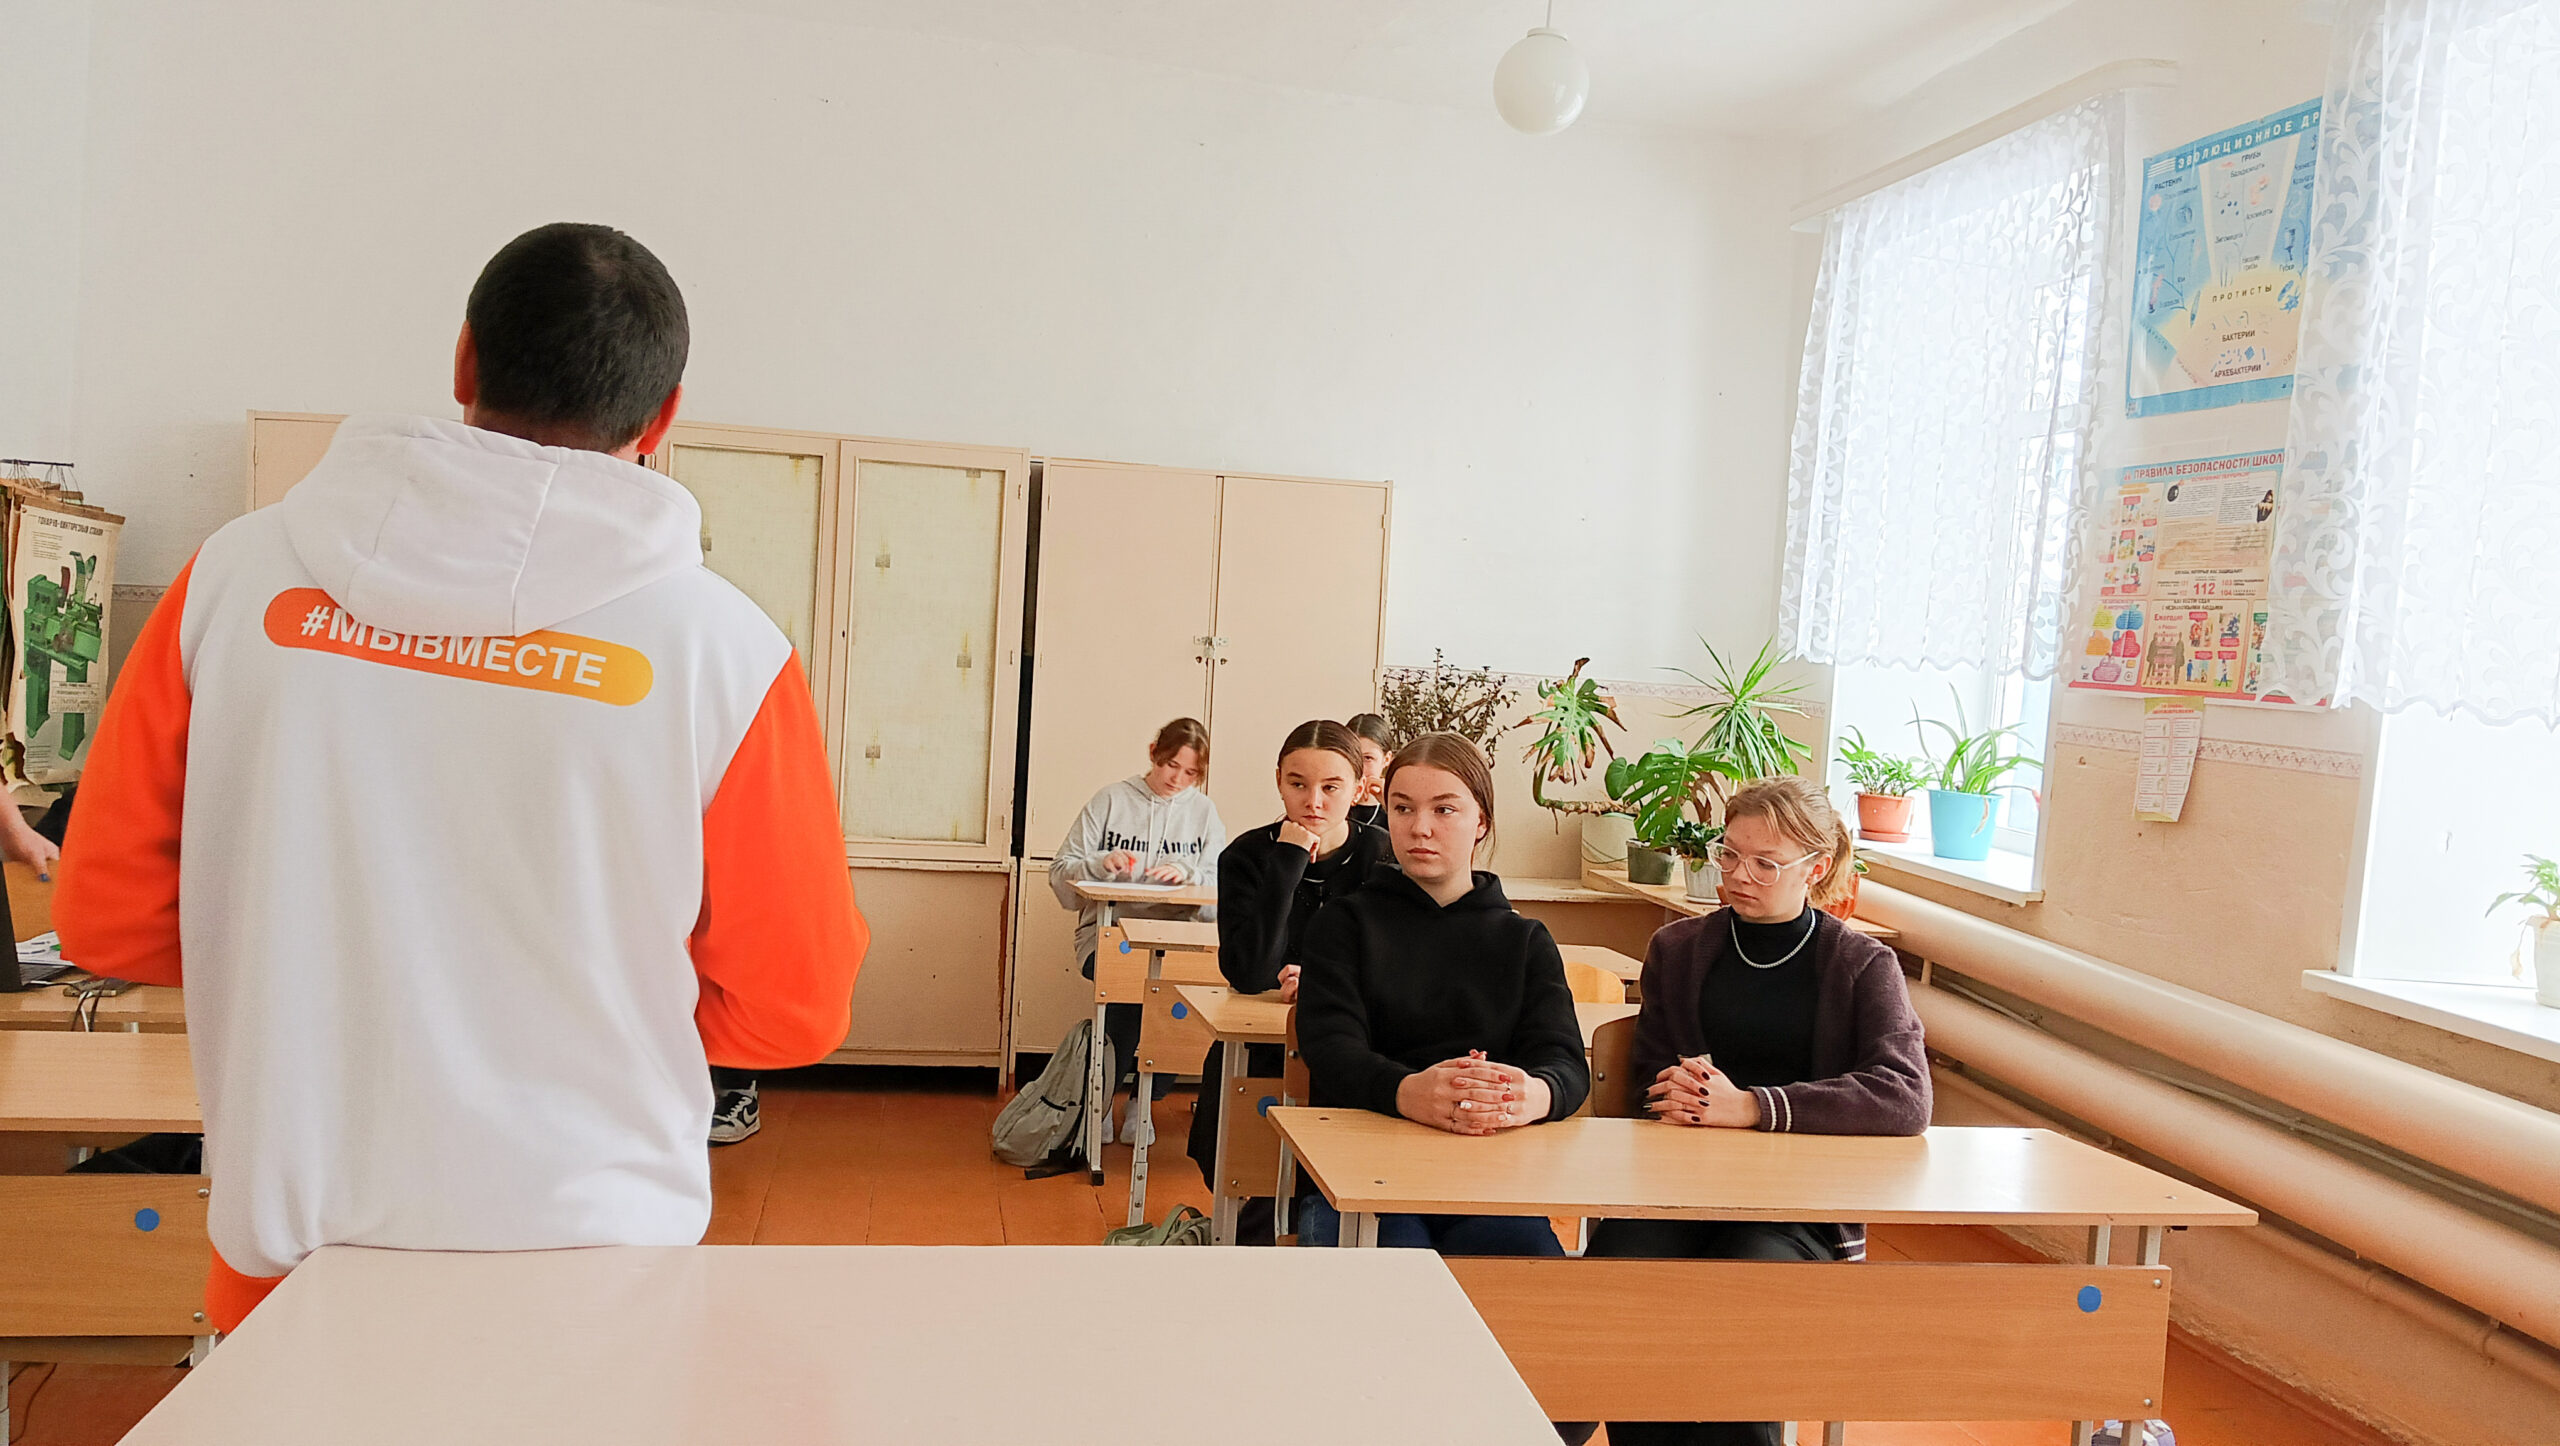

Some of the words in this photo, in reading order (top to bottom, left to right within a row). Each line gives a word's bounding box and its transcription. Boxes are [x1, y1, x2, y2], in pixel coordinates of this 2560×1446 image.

[2178, 120, 2293, 169] ЭВОЛЮЦИОННОЕ
[2212, 284, 2273, 303] ПРОТИСТЫ
[2222, 330, 2255, 342] БАКТЕРИИ
[2214, 364, 2262, 378] АРХЕБАКТЕРИИ
[2134, 467, 2174, 480] ПРАВИЛА
[2176, 457, 2250, 476] БЕЗОПАСНОСТИ
[2193, 582, 2216, 595] 112
[301, 604, 607, 689] #МЫВМЕСТЕ
